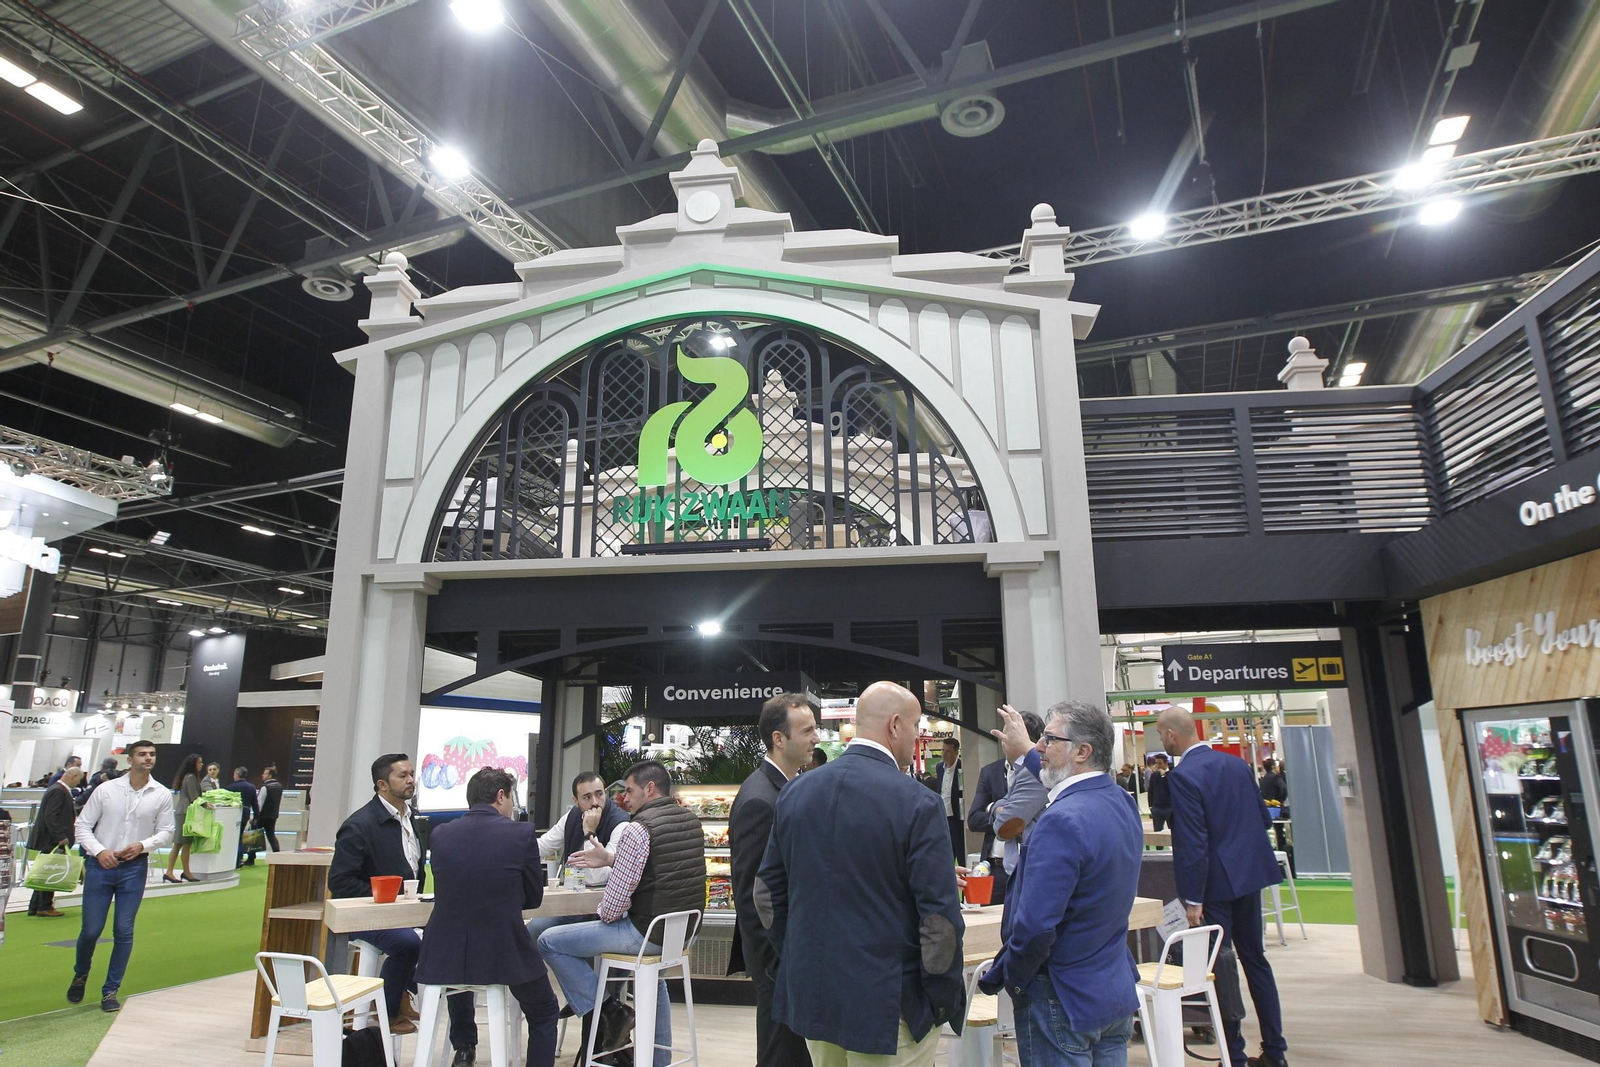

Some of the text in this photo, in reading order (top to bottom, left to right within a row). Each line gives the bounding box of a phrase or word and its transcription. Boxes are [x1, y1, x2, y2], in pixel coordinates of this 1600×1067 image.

[612, 489, 790, 523] RIJK ZWAAN
[1520, 484, 1597, 526] On the
[1465, 621, 1532, 666] Boost
[1187, 653, 1203, 661] Gate
[1188, 665, 1289, 684] Departures
[663, 683, 783, 701] Convenience
